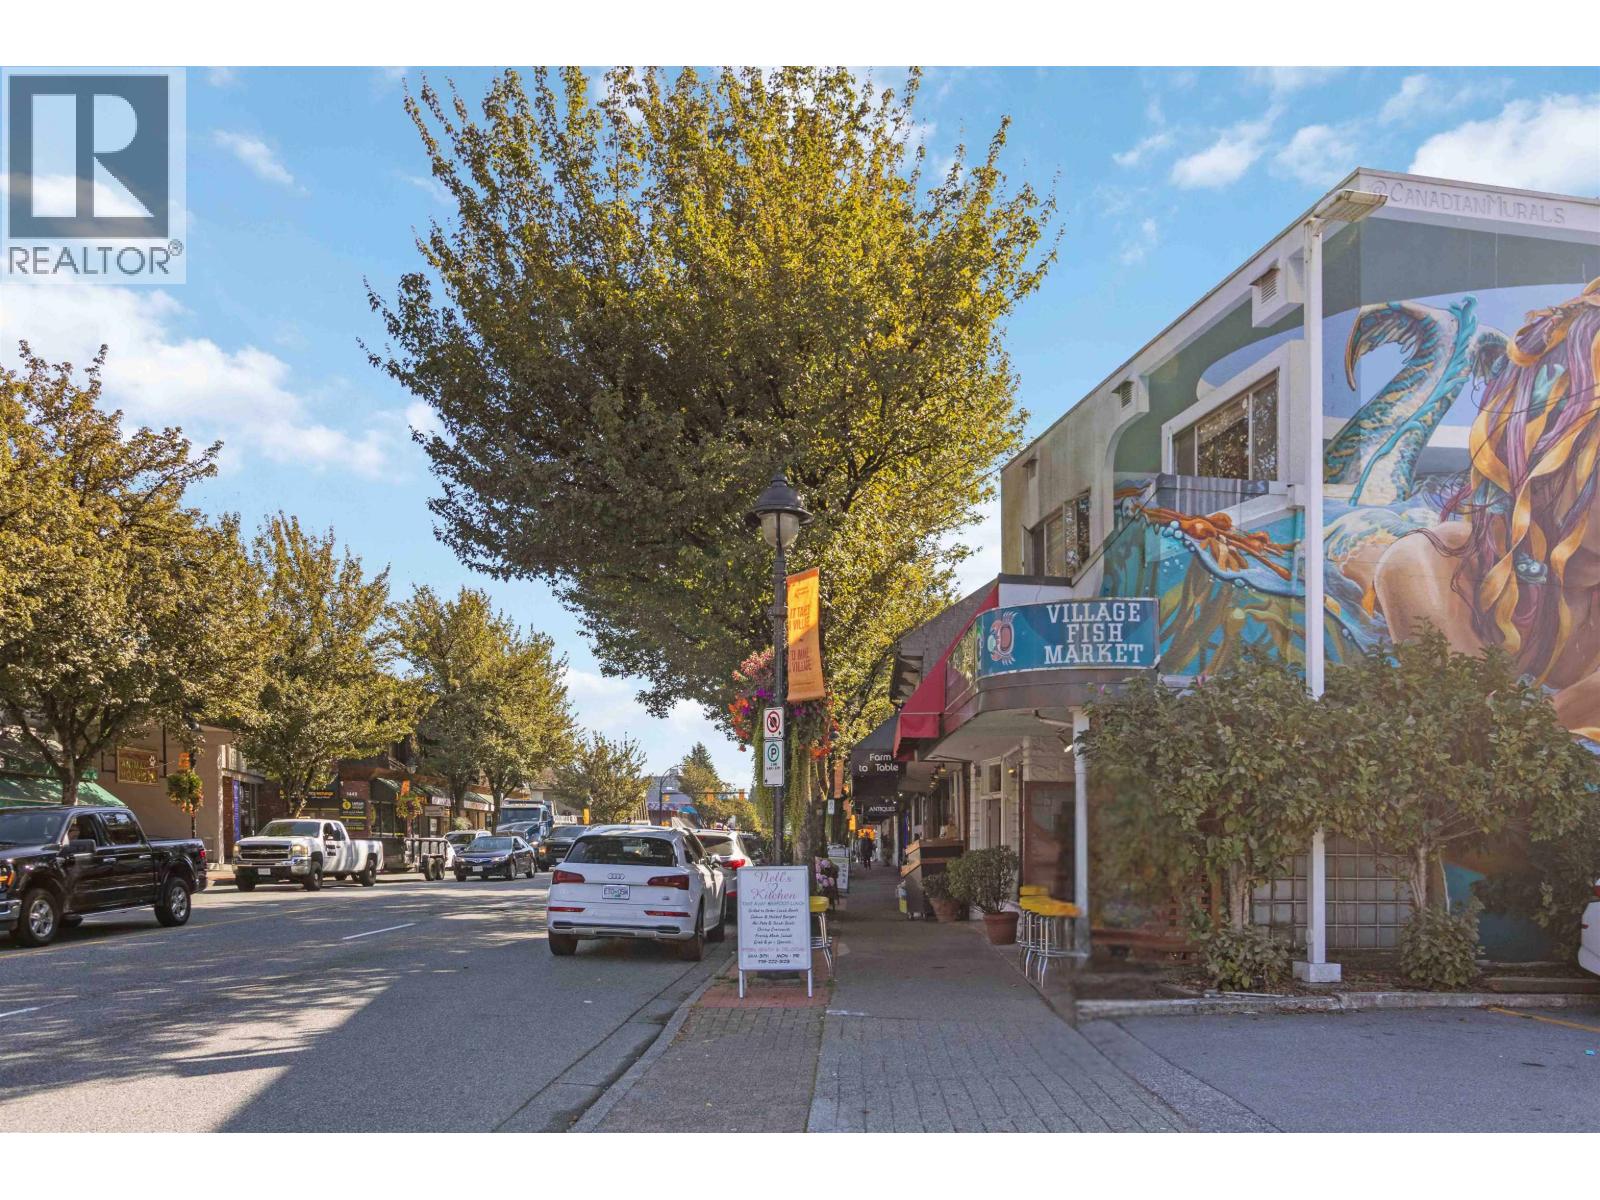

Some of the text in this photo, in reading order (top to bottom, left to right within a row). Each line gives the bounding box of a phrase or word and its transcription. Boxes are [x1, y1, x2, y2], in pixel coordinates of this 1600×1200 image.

[1047, 602, 1141, 624] VILLAGE
[1066, 623, 1124, 643] FISH
[1044, 643, 1144, 665] MARKET
[869, 753, 892, 761] Farm
[858, 763, 899, 772] to Table
[750, 888, 797, 901] Kitchen
